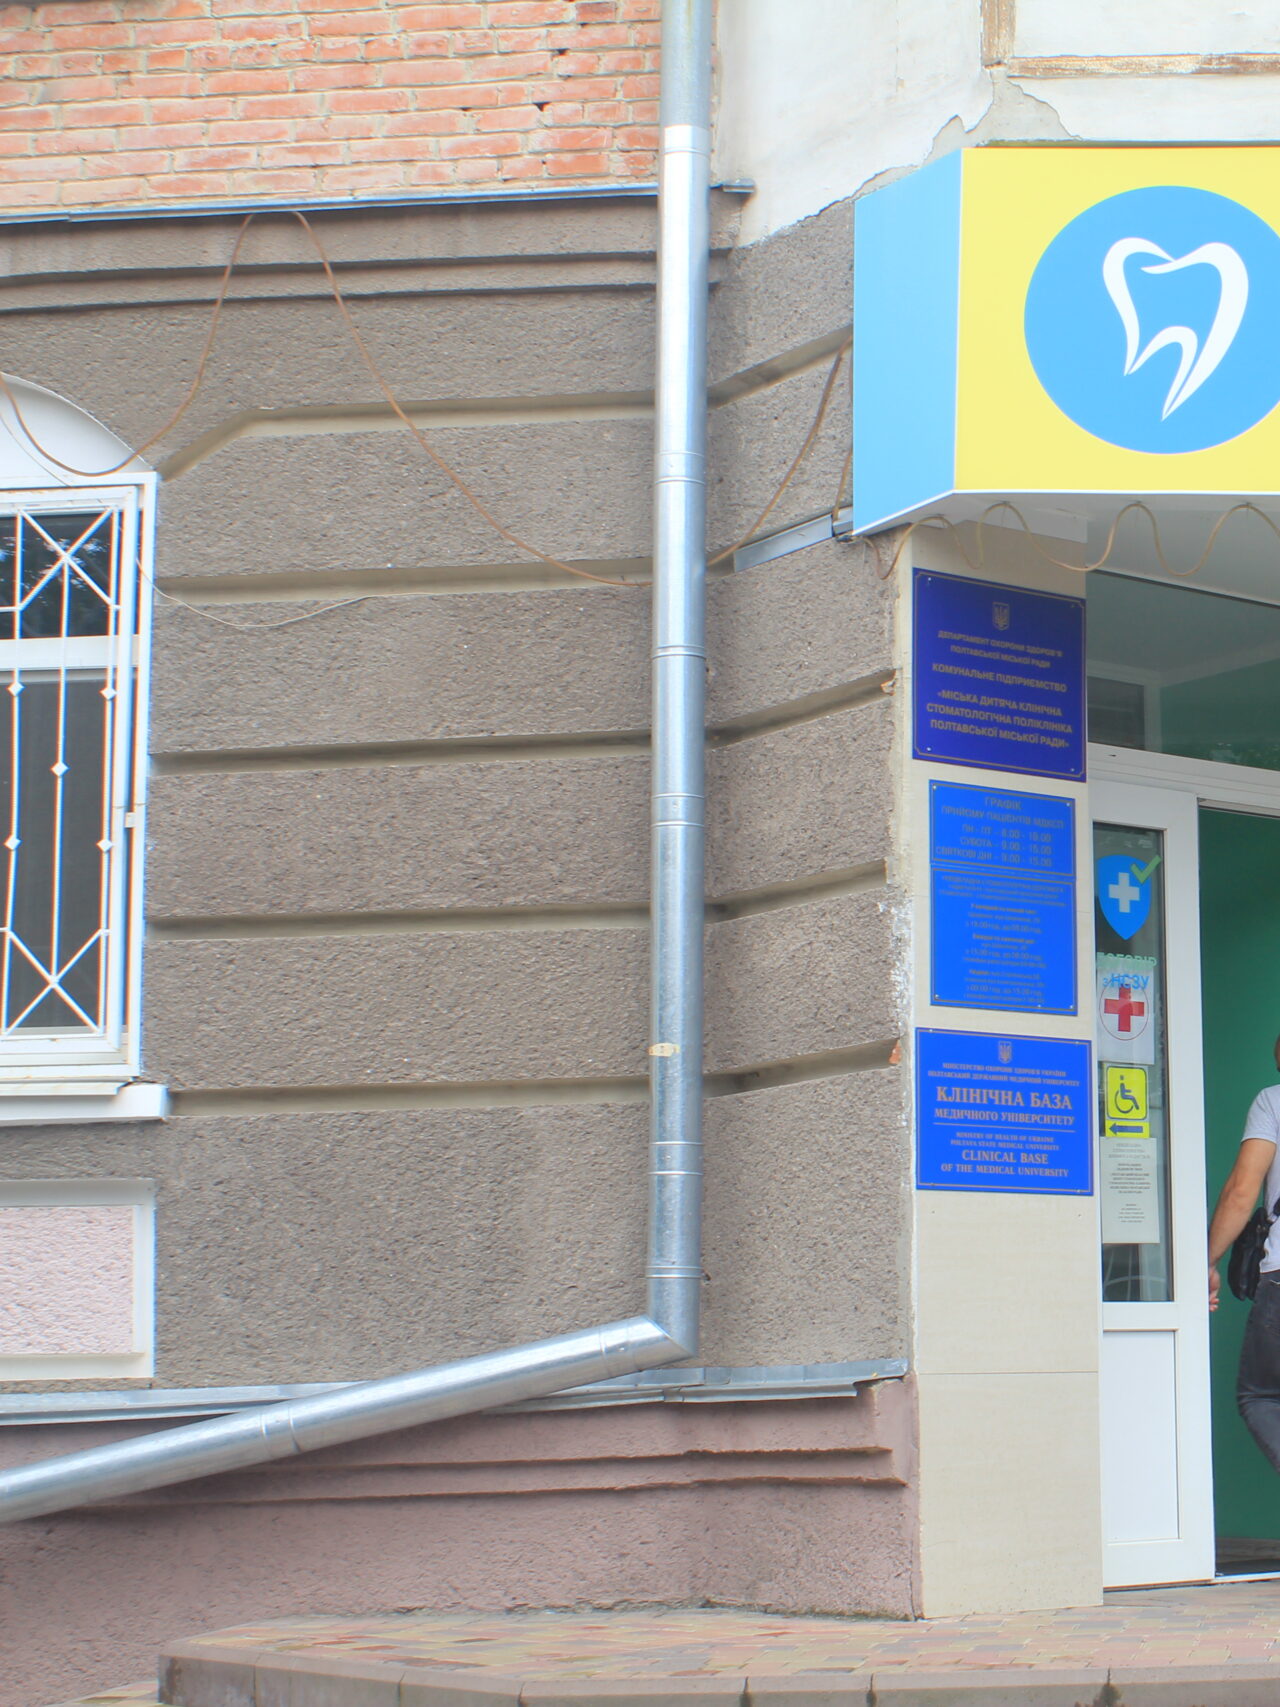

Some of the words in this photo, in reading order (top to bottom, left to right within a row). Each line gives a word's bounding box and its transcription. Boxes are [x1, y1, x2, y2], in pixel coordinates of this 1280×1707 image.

[932, 663, 995, 681] КОМУНАЛЬНЕ
[996, 673, 1067, 692] ПІДПРИЄМСТВО
[937, 689, 978, 704] «МІСЬКА
[979, 695, 1018, 710] ДИТЯЧА
[1018, 702, 1062, 716] КЛІНІЧНА
[926, 703, 1012, 724] СТОМАТОЛОГІЧНА
[1013, 716, 1072, 734] ПОЛІКЛІНІКА
[930, 719, 998, 738] ПОЛТАВСЬКОЇ
[998, 728, 1038, 744] МІСЬКОЇ
[1040, 736, 1070, 748] РАДИ»
[936, 1086, 1024, 1106] КЛІНІЧНА
[1030, 1092, 1072, 1110] БАЗА
[934, 1108, 998, 1121] МЕДИЧНОГО
[1000, 1112, 1075, 1126] УНІВЕРСИТЕТУ
[962, 1149, 1016, 1163] CLINICAL
[1020, 1152, 1049, 1164] BASE
[940, 1163, 954, 1172] OF
[956, 1164, 974, 1173] THE
[976, 1165, 1015, 1175] MEDICAL
[1018, 1166, 1070, 1177] UNIVERSITY
